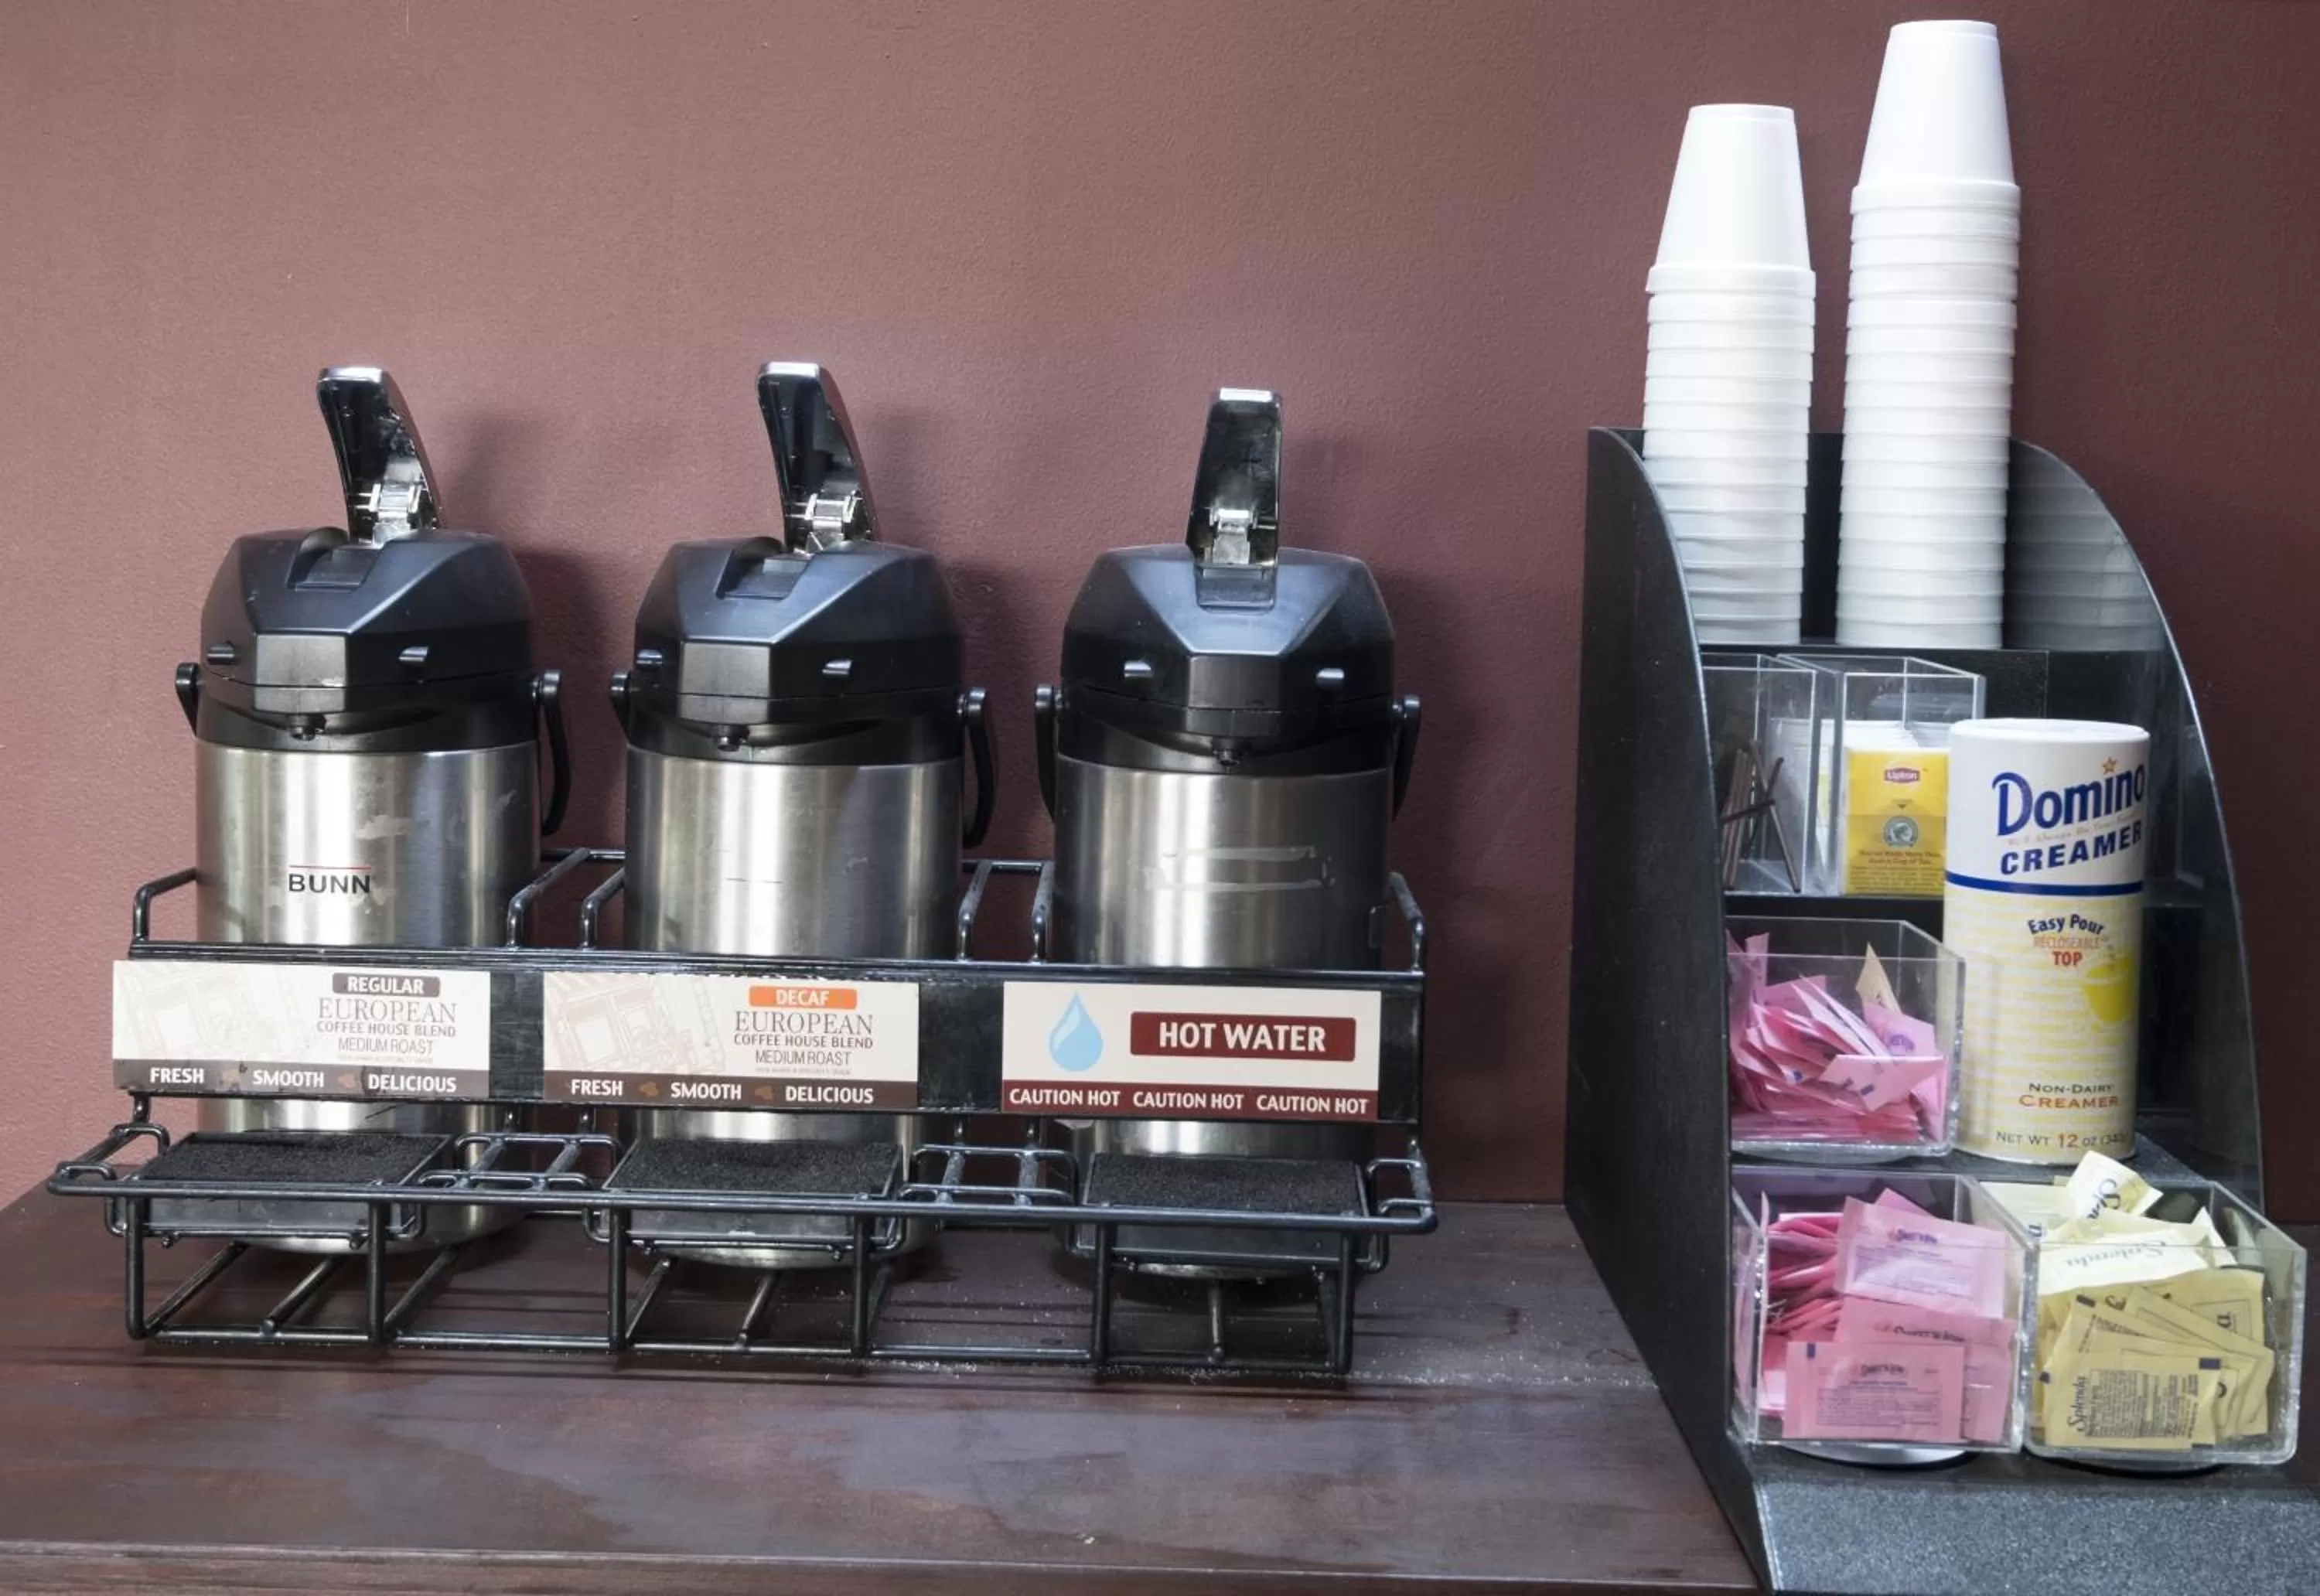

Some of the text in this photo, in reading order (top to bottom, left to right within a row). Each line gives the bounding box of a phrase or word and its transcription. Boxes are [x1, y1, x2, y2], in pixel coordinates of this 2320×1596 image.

[1991, 762, 2145, 836] Domino
[2000, 820, 2141, 875] CREAMER
[288, 873, 370, 893] BUNN
[2028, 913, 2104, 935] Easy Pour
[2052, 951, 2083, 966] TOP
[347, 977, 424, 994] REGULAR
[776, 989, 830, 1006] DECAF
[318, 998, 457, 1023] EUROPEAN
[316, 1021, 456, 1038] COFFEE HOUSE BLEND
[734, 1011, 873, 1035] EUROPEAN
[338, 1037, 434, 1055] MEDIUM ROAST
[734, 1032, 873, 1049] COFFEE HOUSE BLEND
[1159, 1021, 1326, 1052] HOT WATER
[756, 1049, 852, 1066] MEDIUM ROAST
[150, 1067, 457, 1092] FRESH SMOOTH DELICIOUS
[571, 1079, 874, 1104] FRESH SMOOTH DELICIOUS
[1009, 1088, 1369, 1113] CAUTION HOT CAUTION HOT CAUTION HOT
[2059, 1133, 2079, 1148] 12
[2066, 1376, 2087, 1432] Splenda
